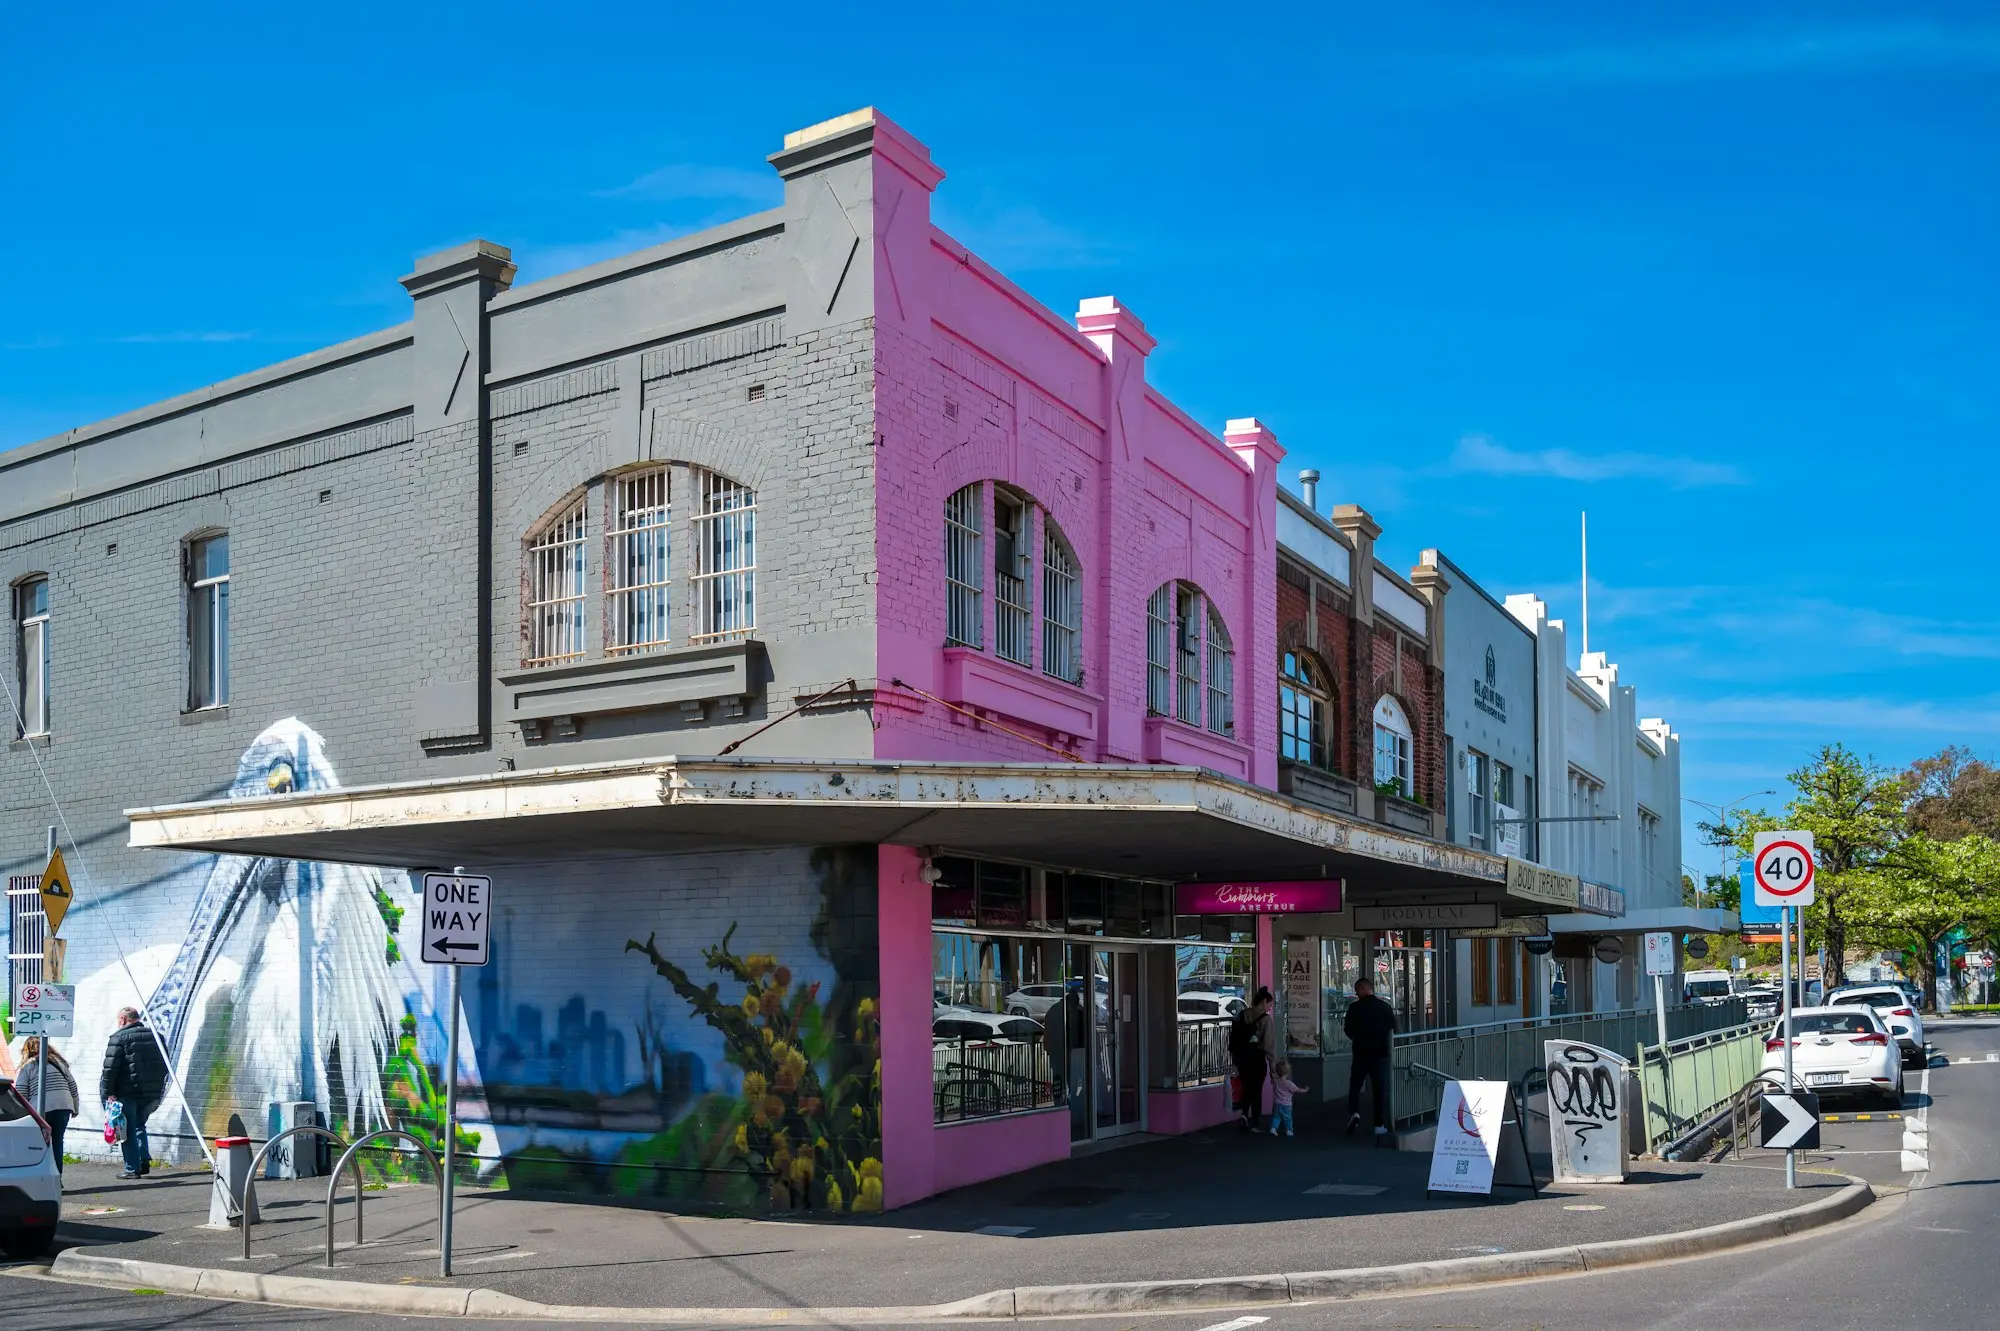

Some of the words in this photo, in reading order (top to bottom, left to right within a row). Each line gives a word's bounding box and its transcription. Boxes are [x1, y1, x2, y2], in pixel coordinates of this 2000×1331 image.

[1765, 857, 1803, 880] 40
[1238, 886, 1260, 894] THE
[1517, 865, 1536, 890] BODY
[1538, 871, 1572, 898] TREATMENT
[435, 883, 480, 904] ONE
[1214, 884, 1278, 904] Rumours
[1266, 903, 1296, 911] TRUE
[431, 910, 482, 931] WAY
[19, 1011, 42, 1024] 2P
